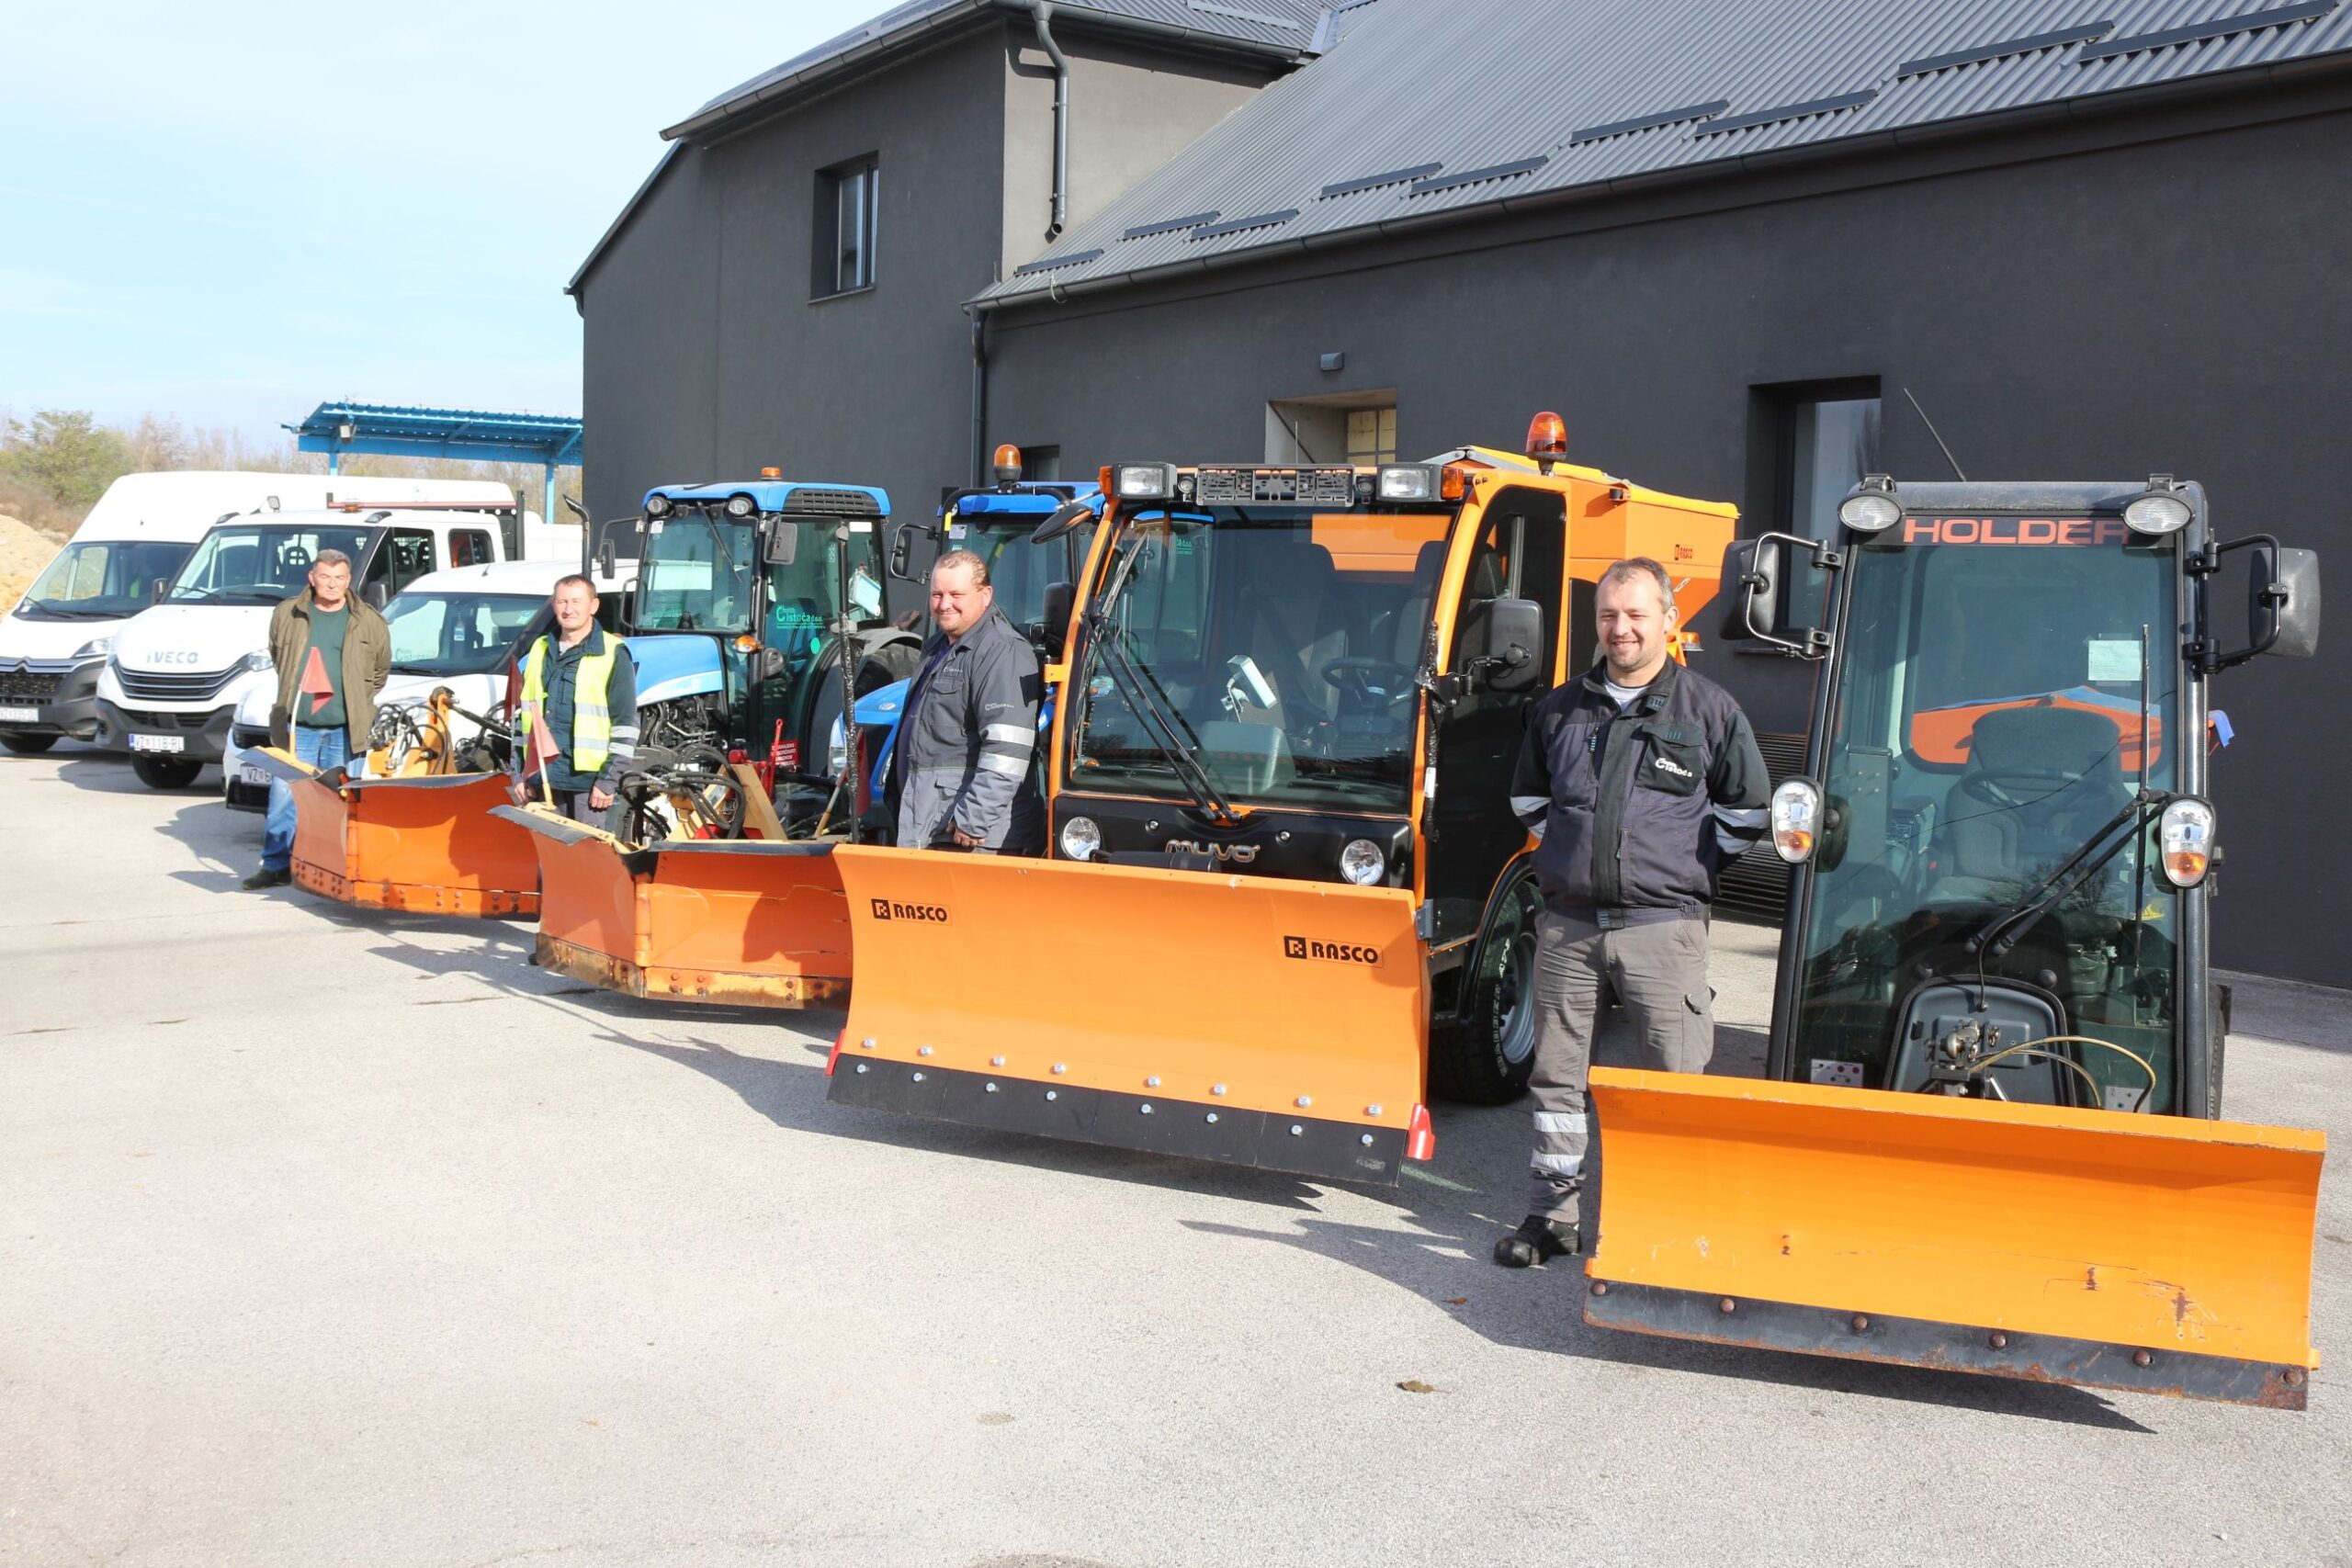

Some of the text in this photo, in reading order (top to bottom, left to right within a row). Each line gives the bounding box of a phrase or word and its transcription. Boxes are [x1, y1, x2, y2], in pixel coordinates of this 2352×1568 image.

[1903, 519, 2129, 545] HOLDER
[146, 651, 199, 664] IVECO
[247, 767, 258, 782] VZ
[893, 903, 947, 922] RASCO
[1311, 942, 1379, 964] RASCO
